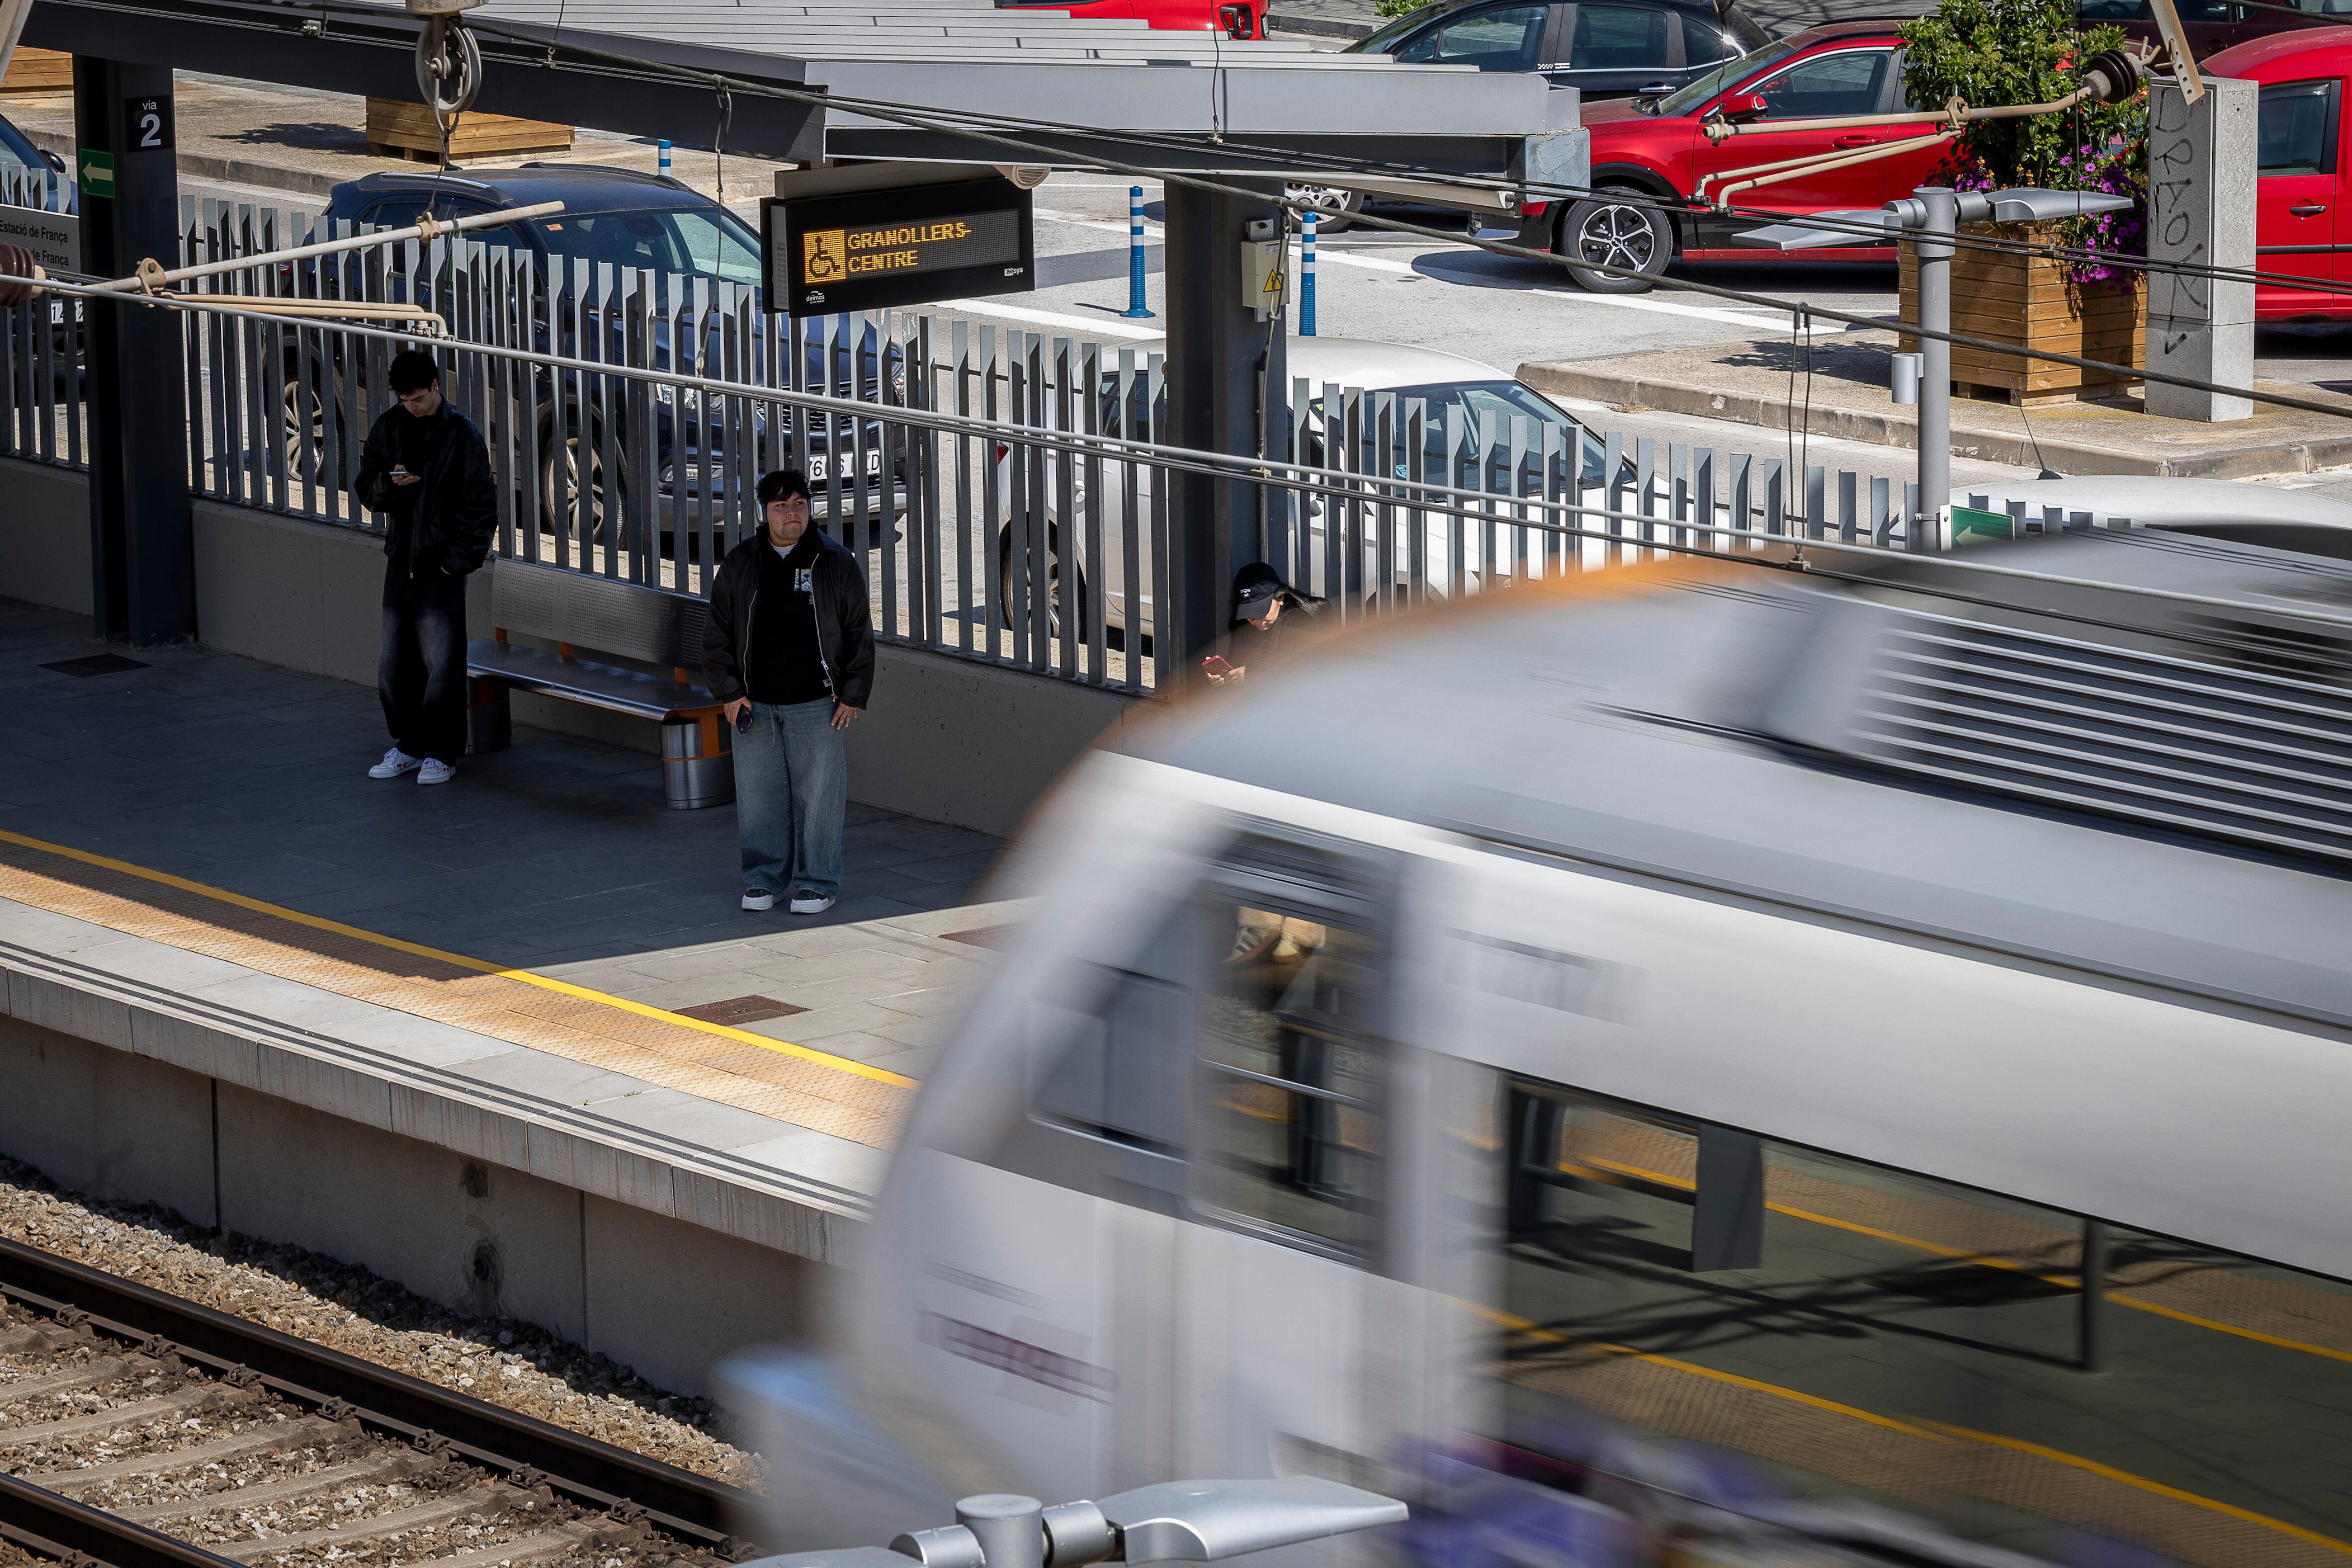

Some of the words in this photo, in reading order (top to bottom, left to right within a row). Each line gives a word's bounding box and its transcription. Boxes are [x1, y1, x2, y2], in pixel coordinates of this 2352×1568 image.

[142, 100, 157, 110] via
[140, 114, 161, 147] 2
[0, 220, 27, 236] Estació
[29, 225, 39, 238] de
[41, 226, 68, 245] França
[847, 223, 972, 249] GRANOLLERS-
[42, 250, 69, 268] França
[848, 250, 918, 272] CENTRE
